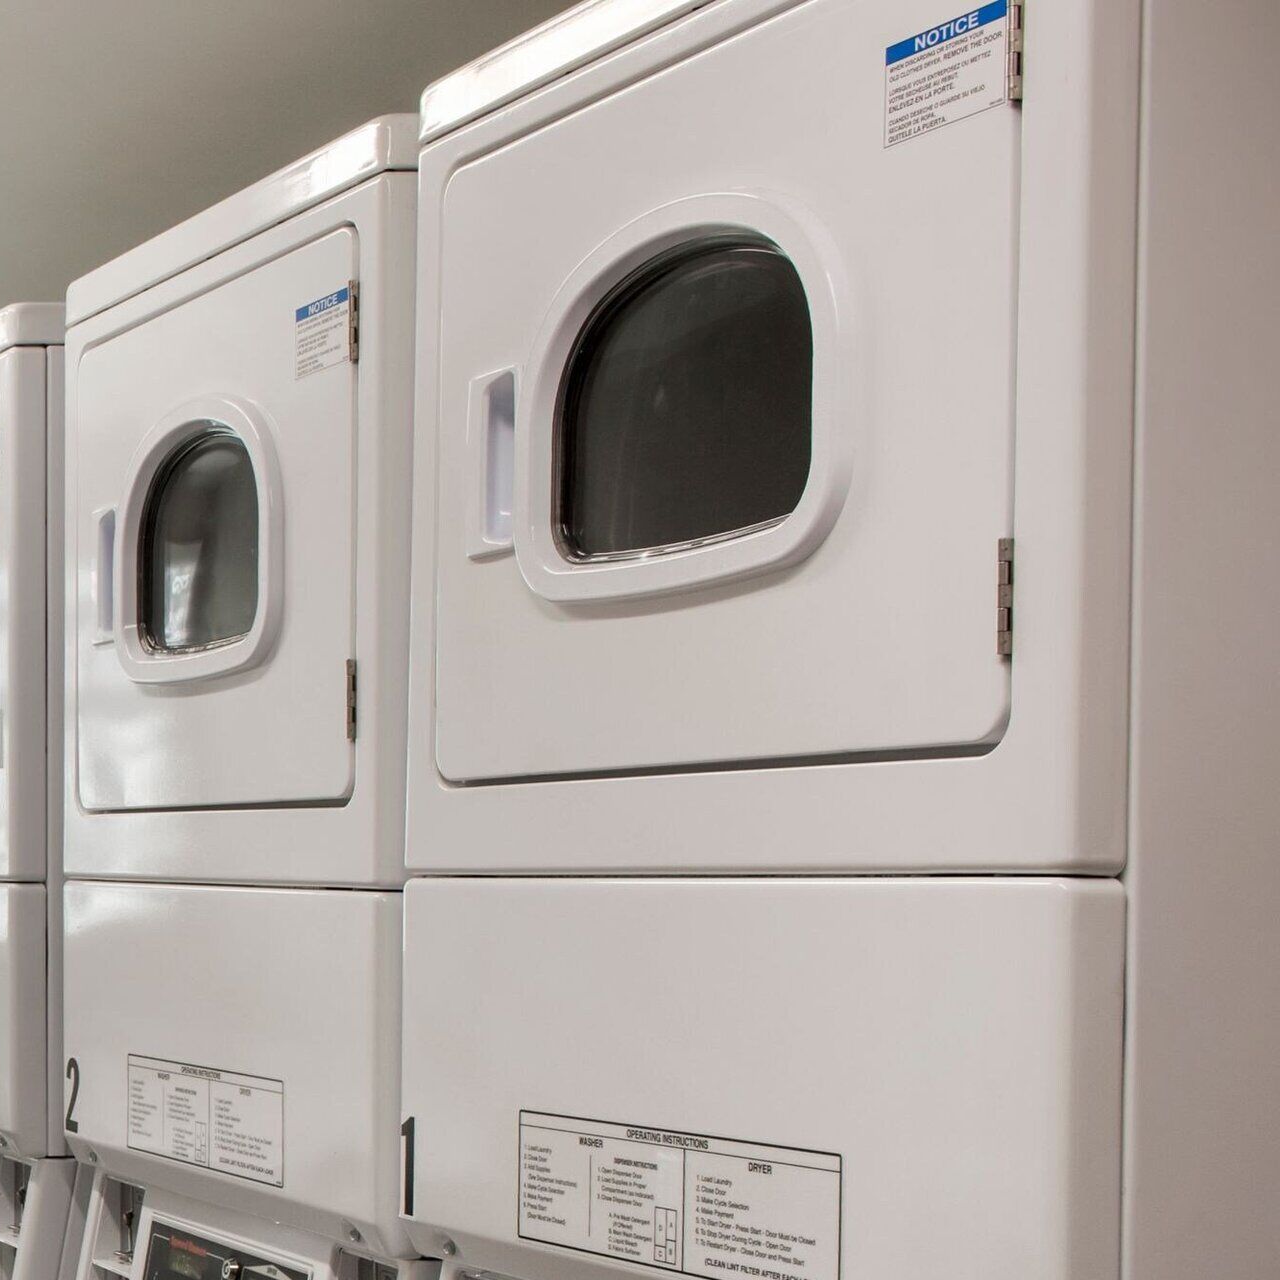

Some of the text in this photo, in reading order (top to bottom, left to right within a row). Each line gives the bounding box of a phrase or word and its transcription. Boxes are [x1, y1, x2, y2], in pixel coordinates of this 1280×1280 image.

[914, 11, 980, 51] NOTICE
[943, 45, 969, 60] REMOVE
[970, 39, 983, 49] THE
[925, 91, 932, 100] LA
[308, 294, 339, 316] NOTICE
[65, 1057, 80, 1134] 2
[578, 1136, 604, 1149] WASHER
[626, 1129, 709, 1150] OPERATING INSTRUCTIONS
[401, 1116, 415, 1216] 1
[748, 1162, 773, 1175] DRYER
[714, 1188, 727, 1196] Door
[704, 1257, 726, 1270] (CLEAN
[726, 1262, 740, 1272] LINT
[740, 1265, 761, 1276] FILTER
[761, 1269, 781, 1280] AFTER
